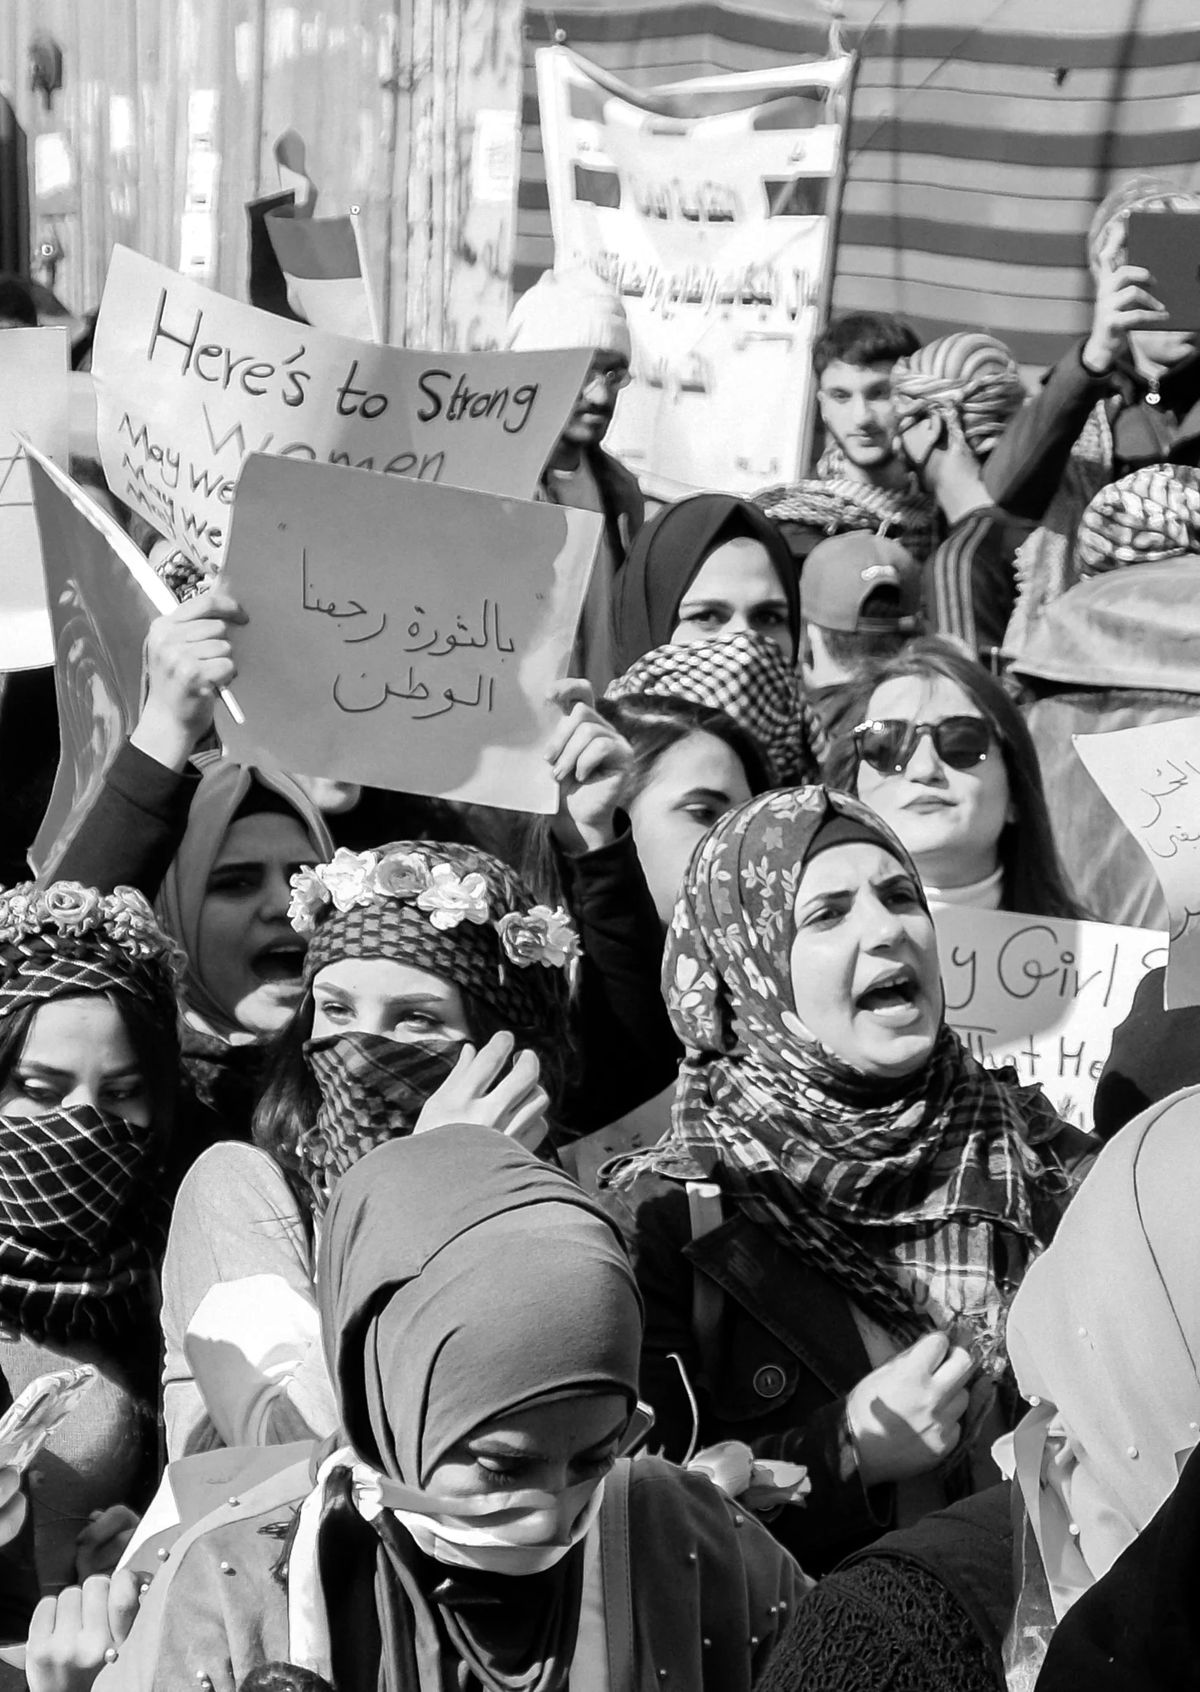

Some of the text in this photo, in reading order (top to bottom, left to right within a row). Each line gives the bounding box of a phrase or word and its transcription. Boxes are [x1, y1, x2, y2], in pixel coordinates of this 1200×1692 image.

[148, 287, 541, 434] Here's to Strong
[117, 411, 181, 489] May
[333, 666, 494, 720] الوطن
